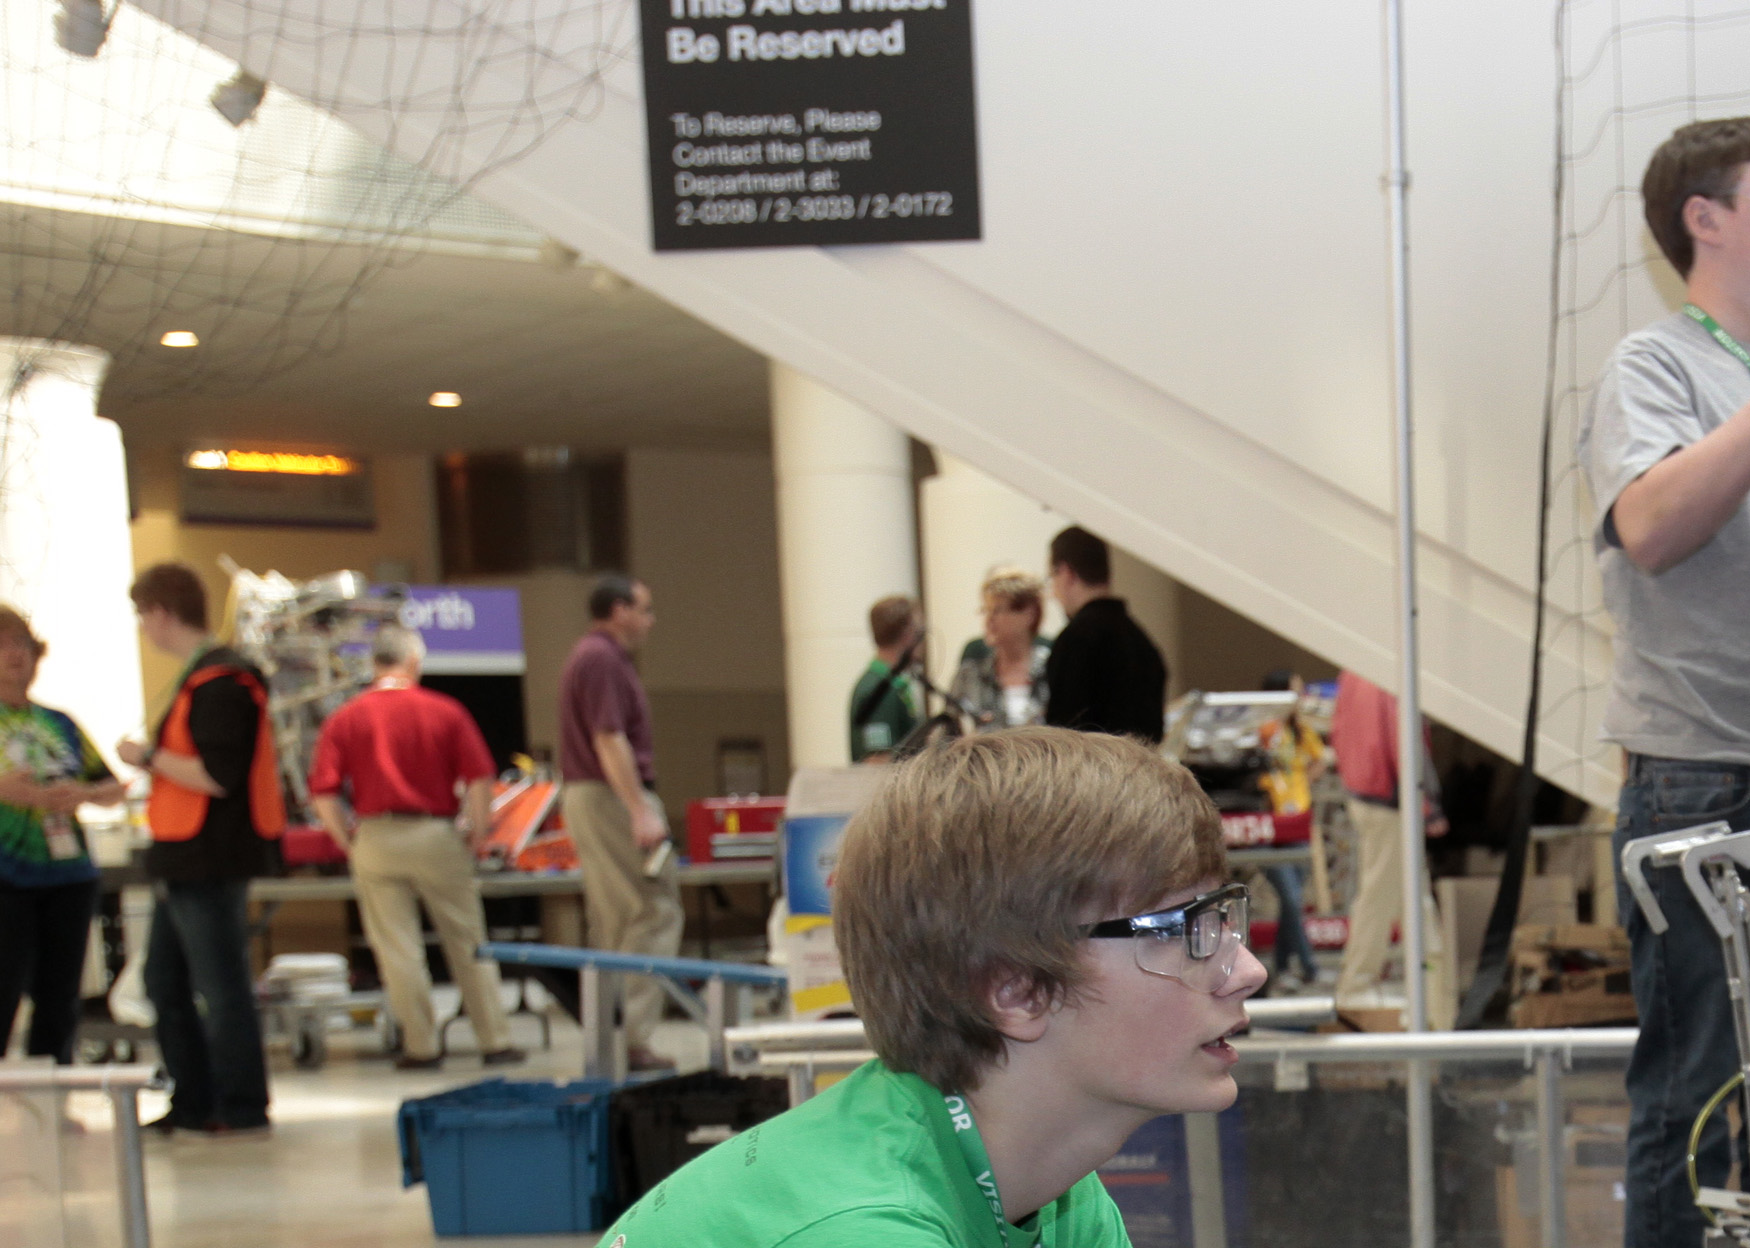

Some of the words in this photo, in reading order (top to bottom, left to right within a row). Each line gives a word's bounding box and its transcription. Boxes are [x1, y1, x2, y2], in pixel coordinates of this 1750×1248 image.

[666, 26, 720, 64] Be
[726, 19, 906, 61] Reserved
[669, 111, 701, 138] To
[804, 108, 882, 133] Please
[672, 141, 763, 168] Contact
[766, 139, 804, 164] the
[806, 137, 872, 162] Event
[674, 168, 806, 199] Department
